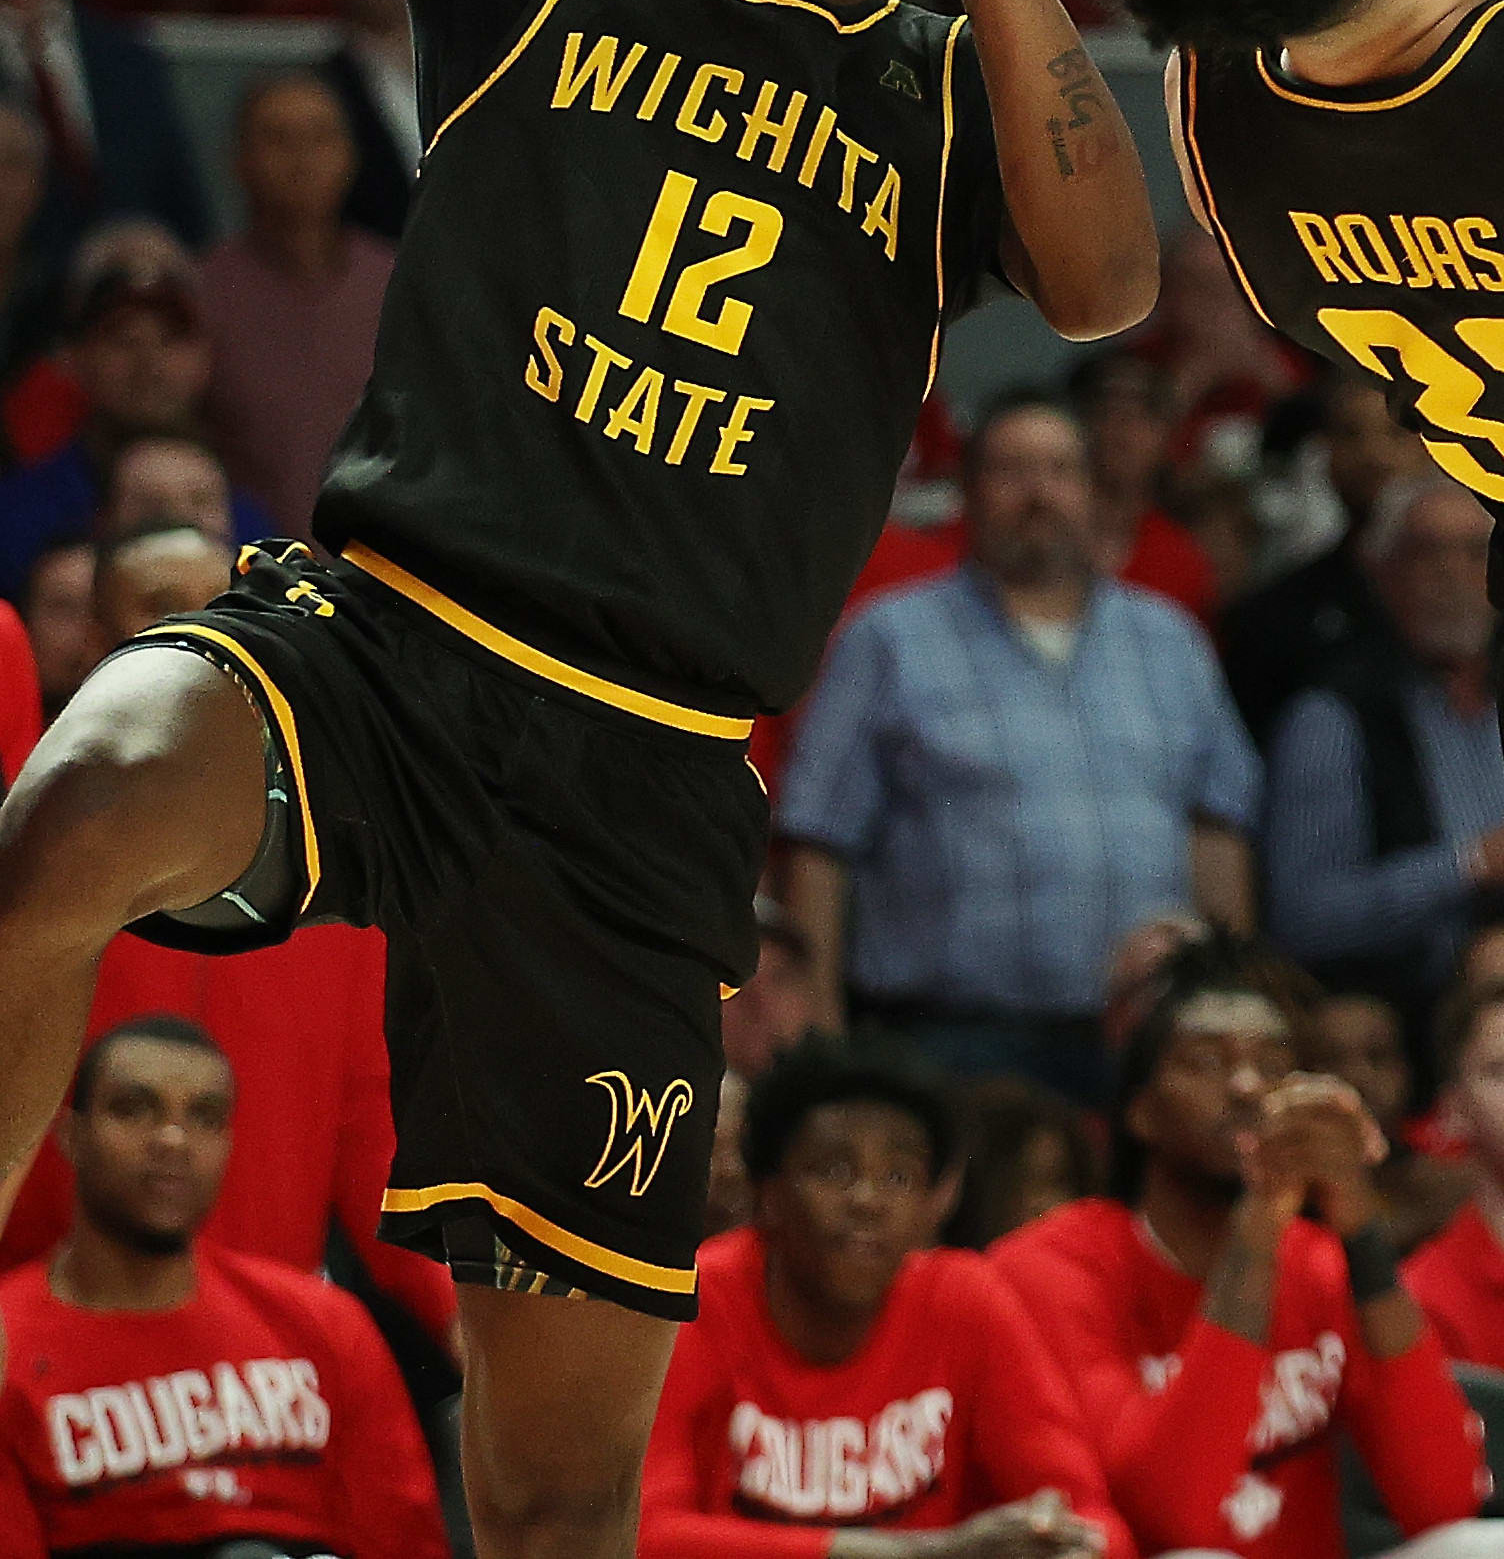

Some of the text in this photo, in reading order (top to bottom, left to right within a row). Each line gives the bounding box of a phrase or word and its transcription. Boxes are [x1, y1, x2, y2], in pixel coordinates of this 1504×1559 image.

[551, 31, 902, 262] WICHITA
[619, 169, 783, 355] 12
[525, 306, 775, 477] STATE
[584, 1069, 694, 1197] W
[47, 1356, 332, 1487] COUGARS
